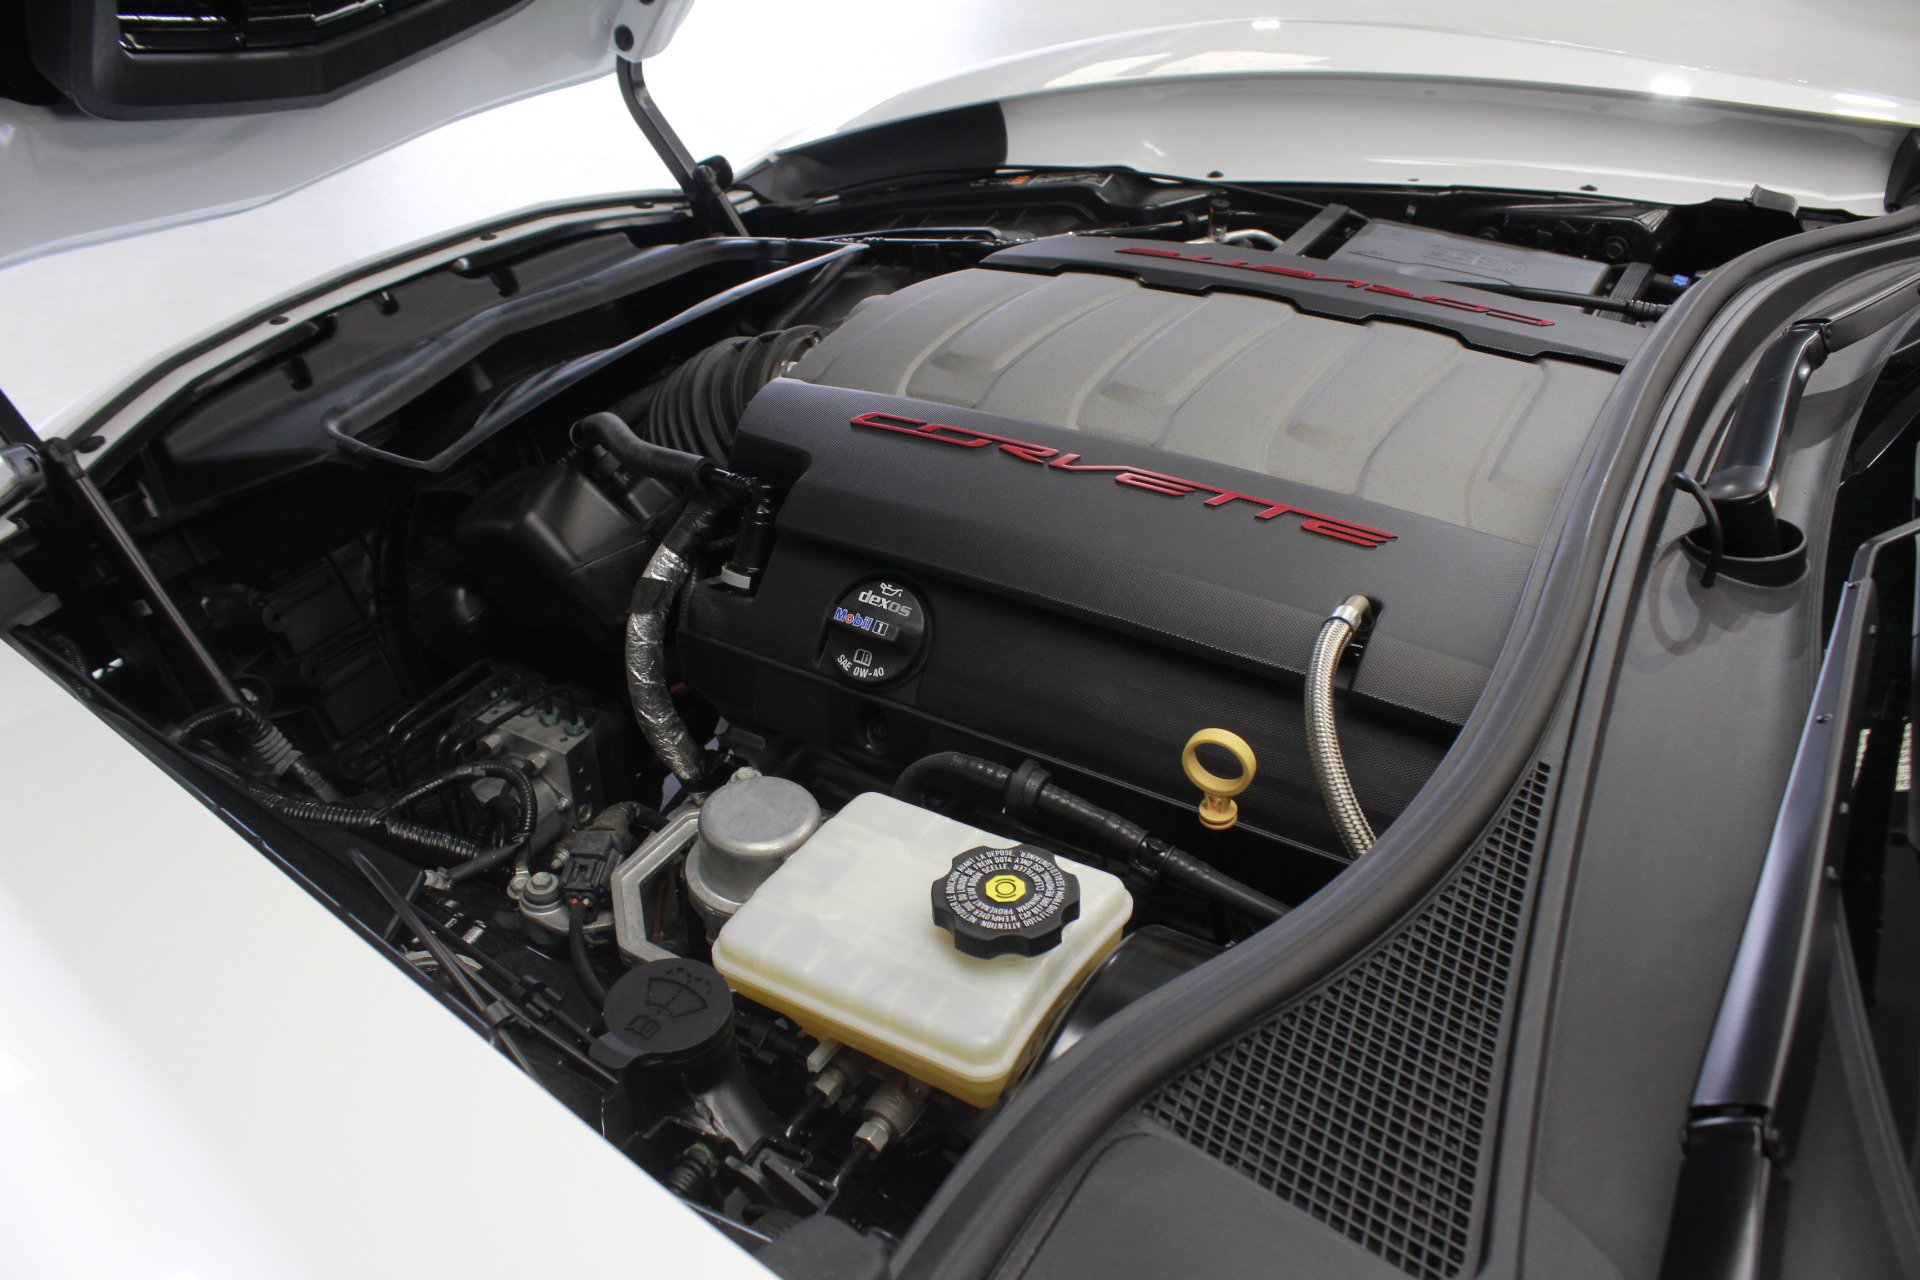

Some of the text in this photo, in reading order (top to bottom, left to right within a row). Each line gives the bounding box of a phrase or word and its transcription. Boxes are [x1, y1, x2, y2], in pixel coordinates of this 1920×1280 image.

[850, 412, 1399, 548] CORVETTE
[858, 590, 912, 617] dexos
[833, 607, 873, 630] Mobil
[837, 654, 885, 678] SAE 0W-40
[957, 857, 976, 872] AVANT
[973, 858, 993, 870] FREIN
[975, 853, 986, 861] LA
[1014, 857, 1033, 867] ONLY
[1030, 862, 1045, 873] USE
[946, 894, 957, 902] LE
[1031, 896, 1053, 914] BEFORE
[950, 901, 978, 923] NETTOYER
[972, 900, 1013, 915] PROVENANT
[1018, 911, 1032, 920] CAP
